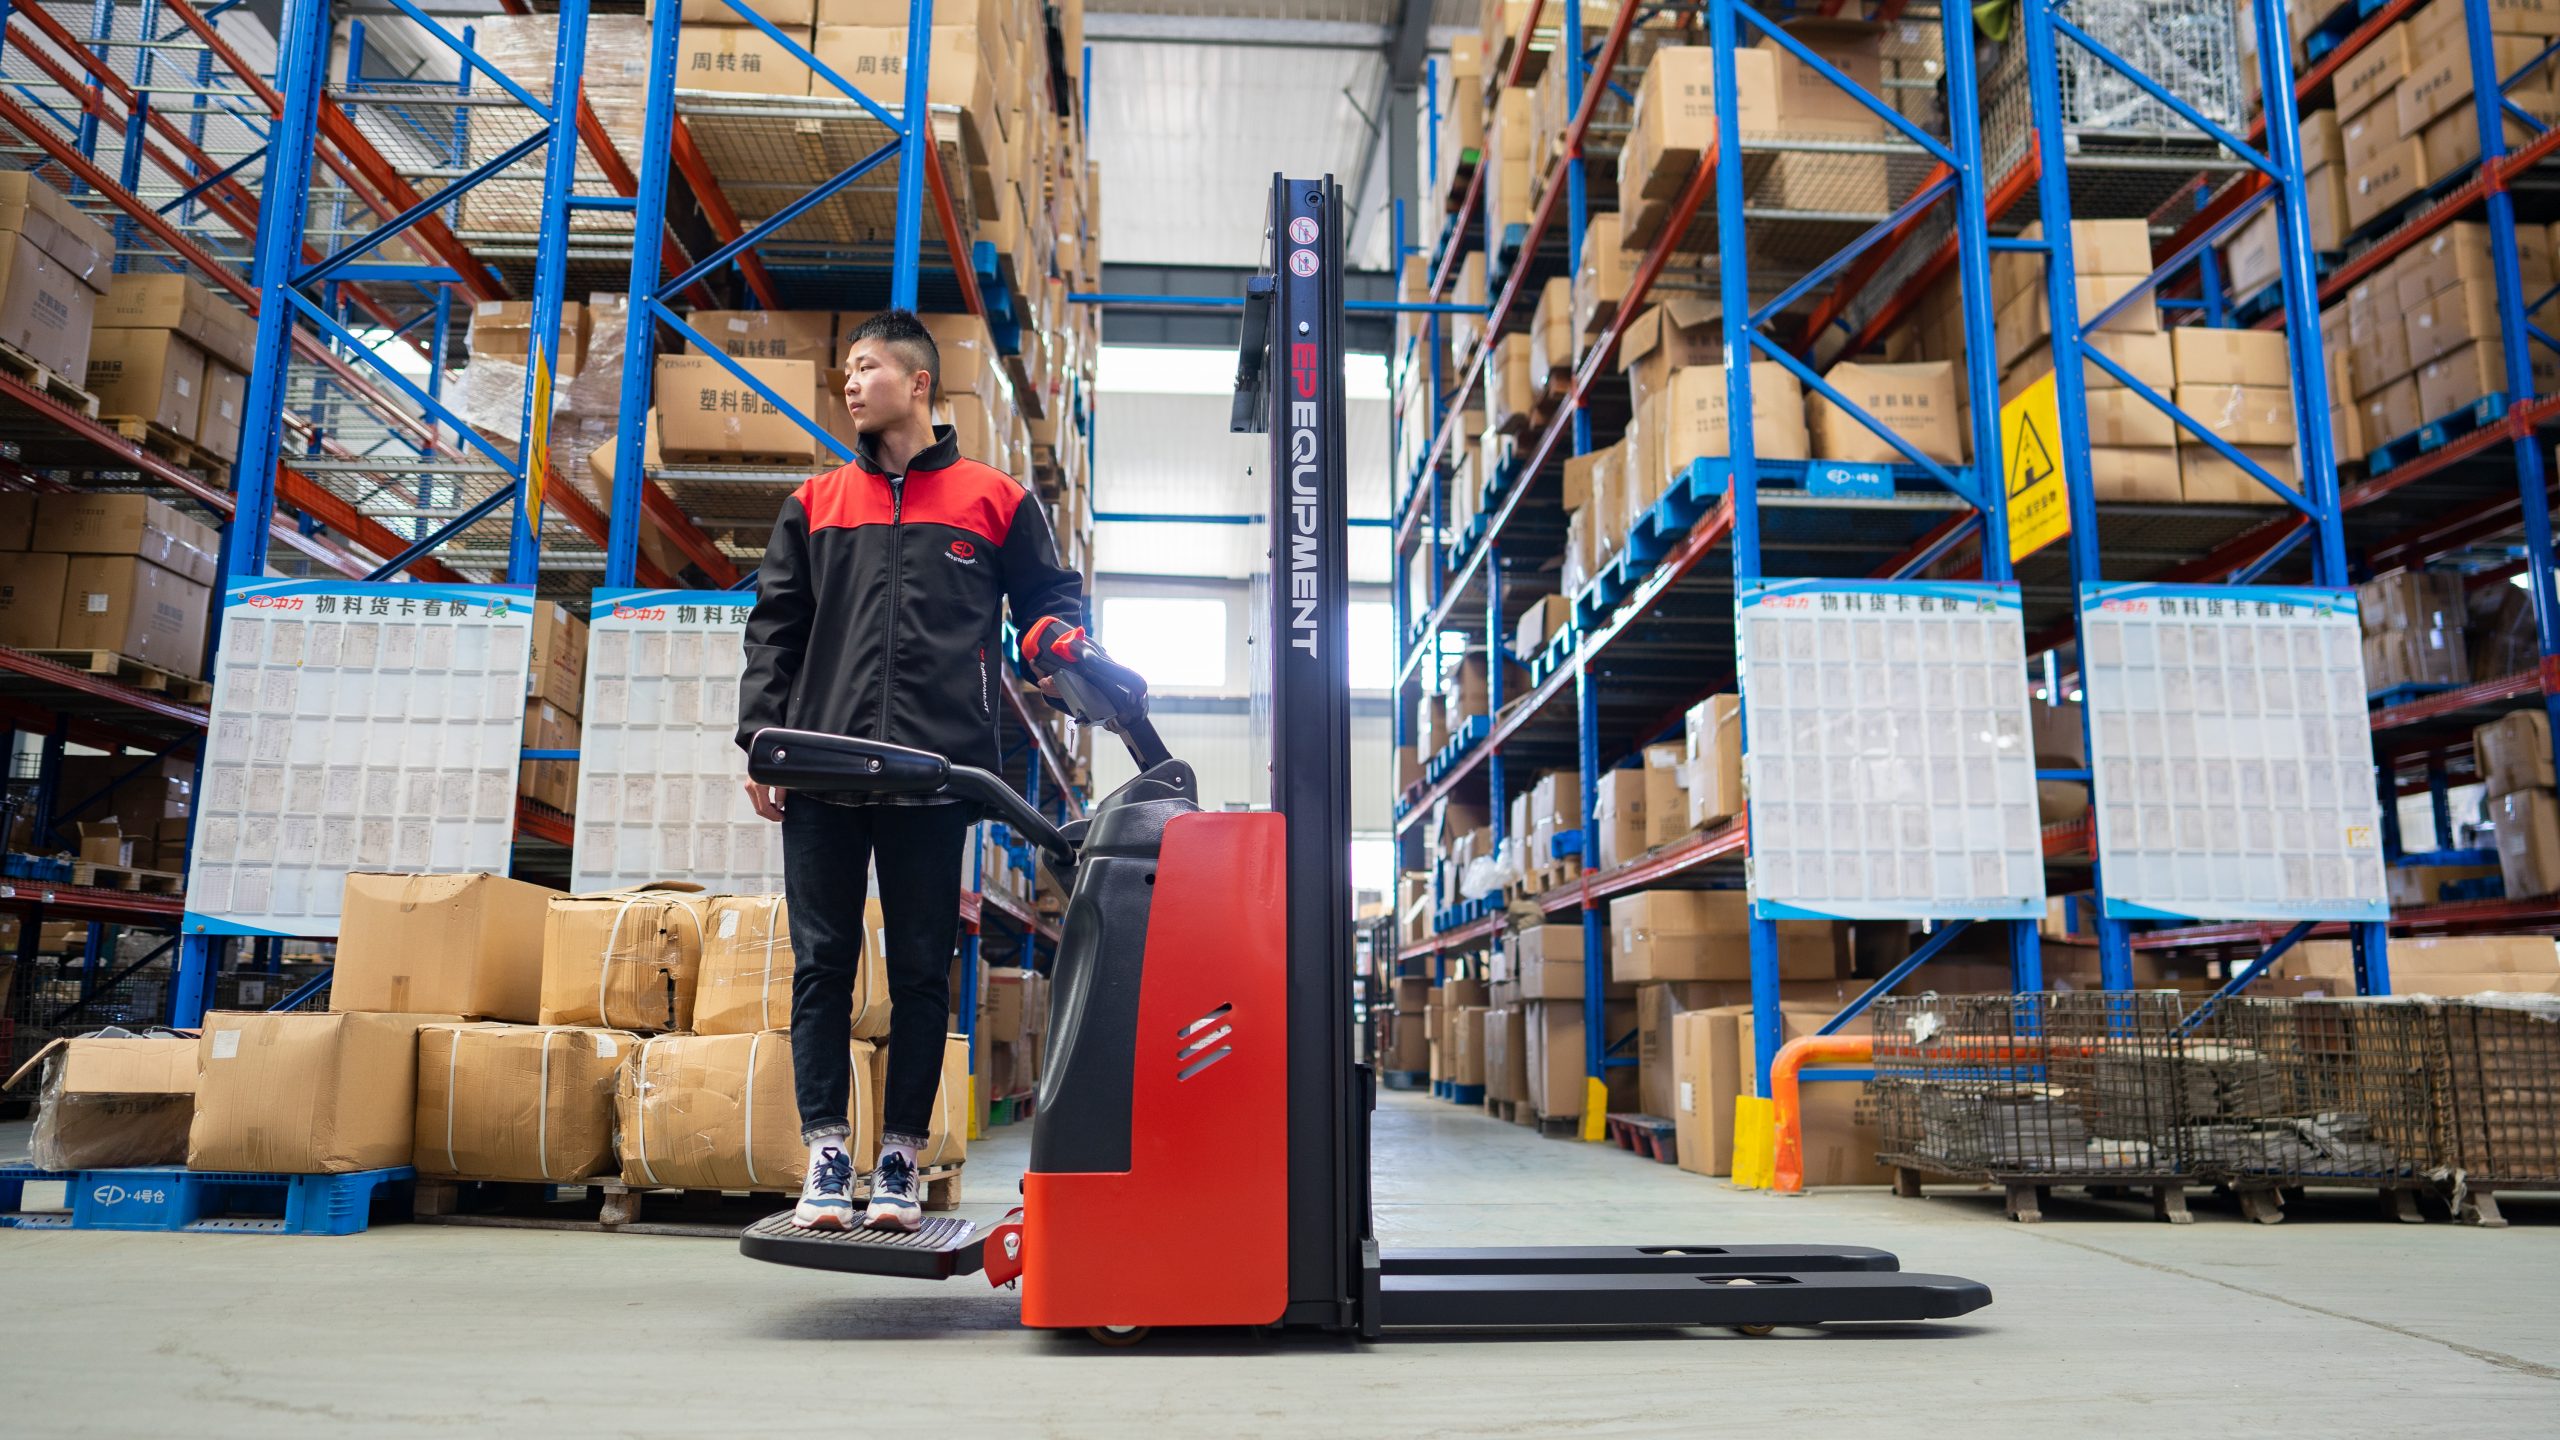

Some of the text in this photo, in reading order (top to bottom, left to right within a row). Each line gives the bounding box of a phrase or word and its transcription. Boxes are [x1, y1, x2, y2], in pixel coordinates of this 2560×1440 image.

[691, 51, 762, 73] 周转箱
[699, 387, 779, 415] 塑料制品
[1290, 343, 1318, 659] EP EQUIPMENT
[950, 540, 975, 558] EP
[315, 594, 470, 617] 物料货卡看板
[1820, 593, 1961, 613] 物料货卡看板
[2159, 597, 2297, 618] 物料货卡看板
